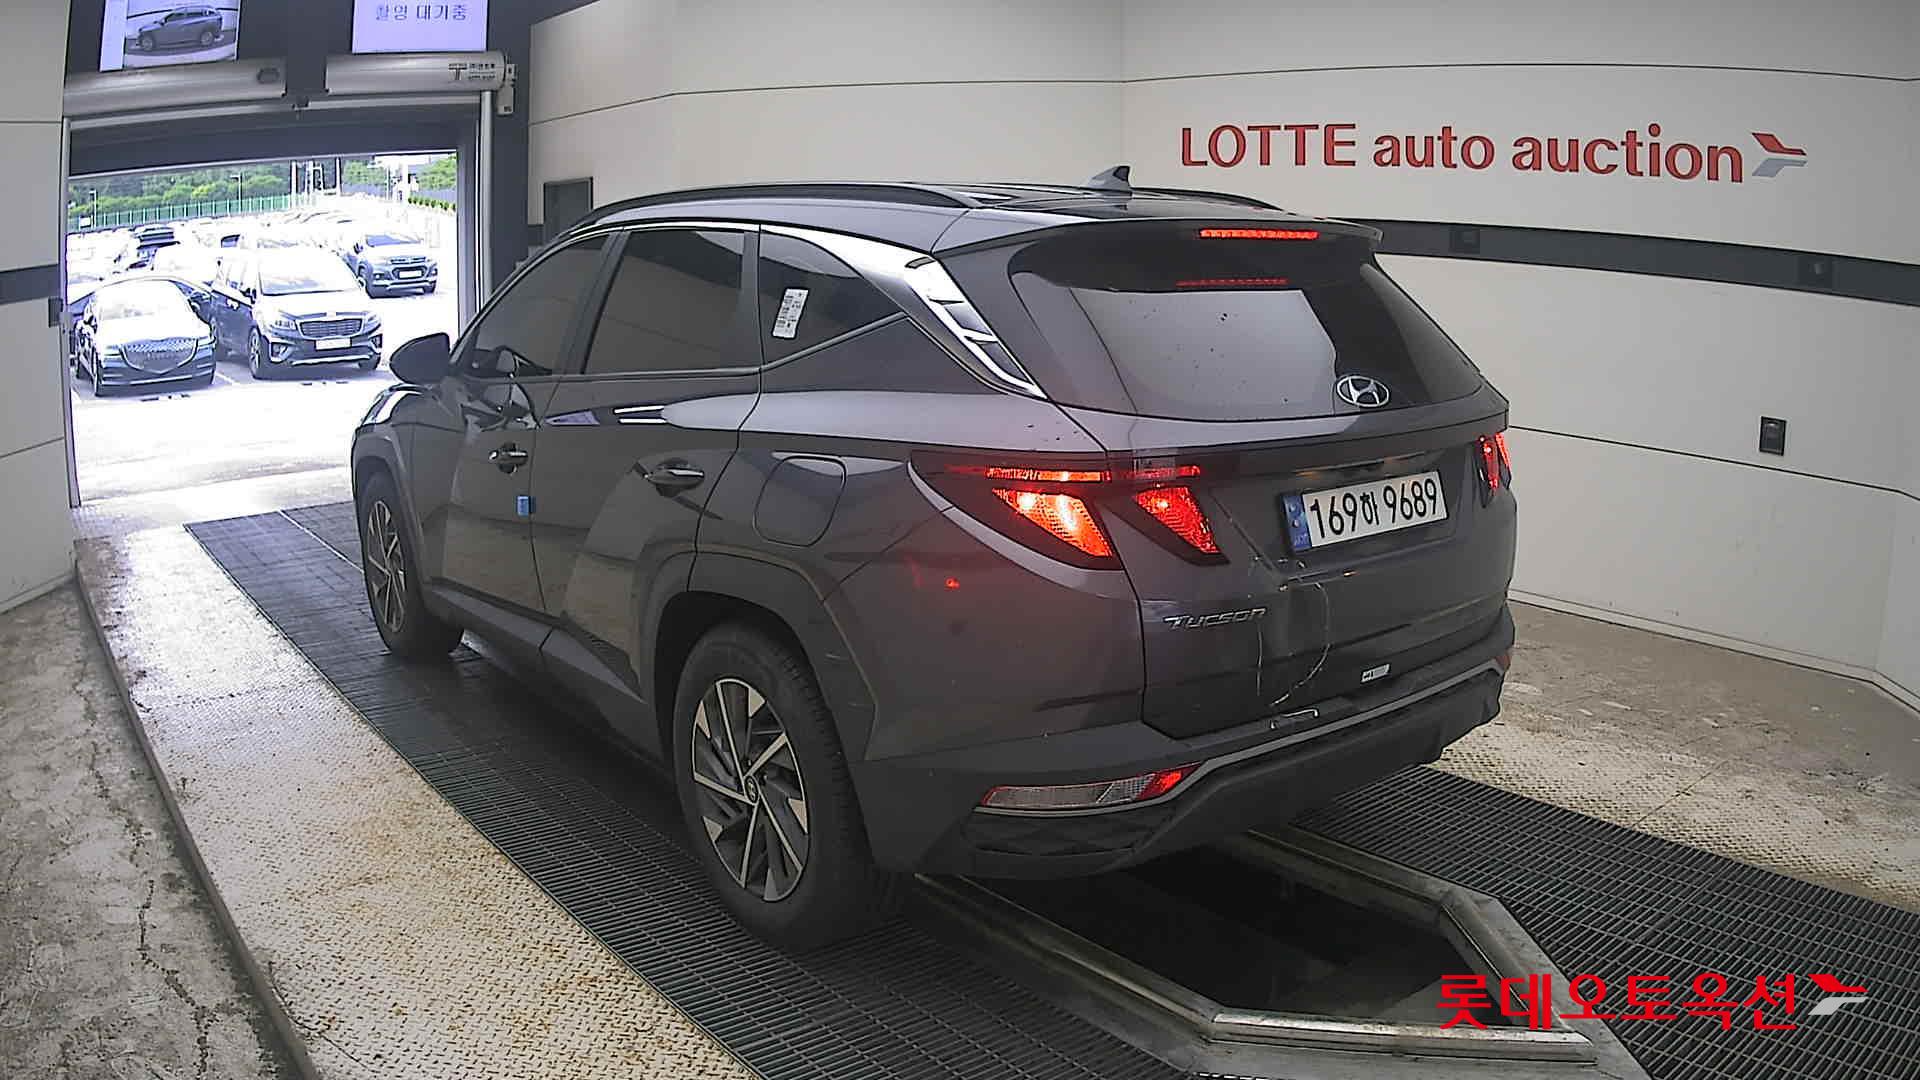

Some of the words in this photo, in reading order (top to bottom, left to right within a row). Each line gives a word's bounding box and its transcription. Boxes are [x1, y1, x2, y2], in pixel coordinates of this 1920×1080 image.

[416, 4, 466, 21] 대기중
[1181, 123, 1356, 168] LOTTE
[1373, 126, 1496, 170] auto
[1512, 123, 1743, 183] auction
[1310, 491, 1380, 539] 169하
[1383, 478, 1437, 524] 9689
